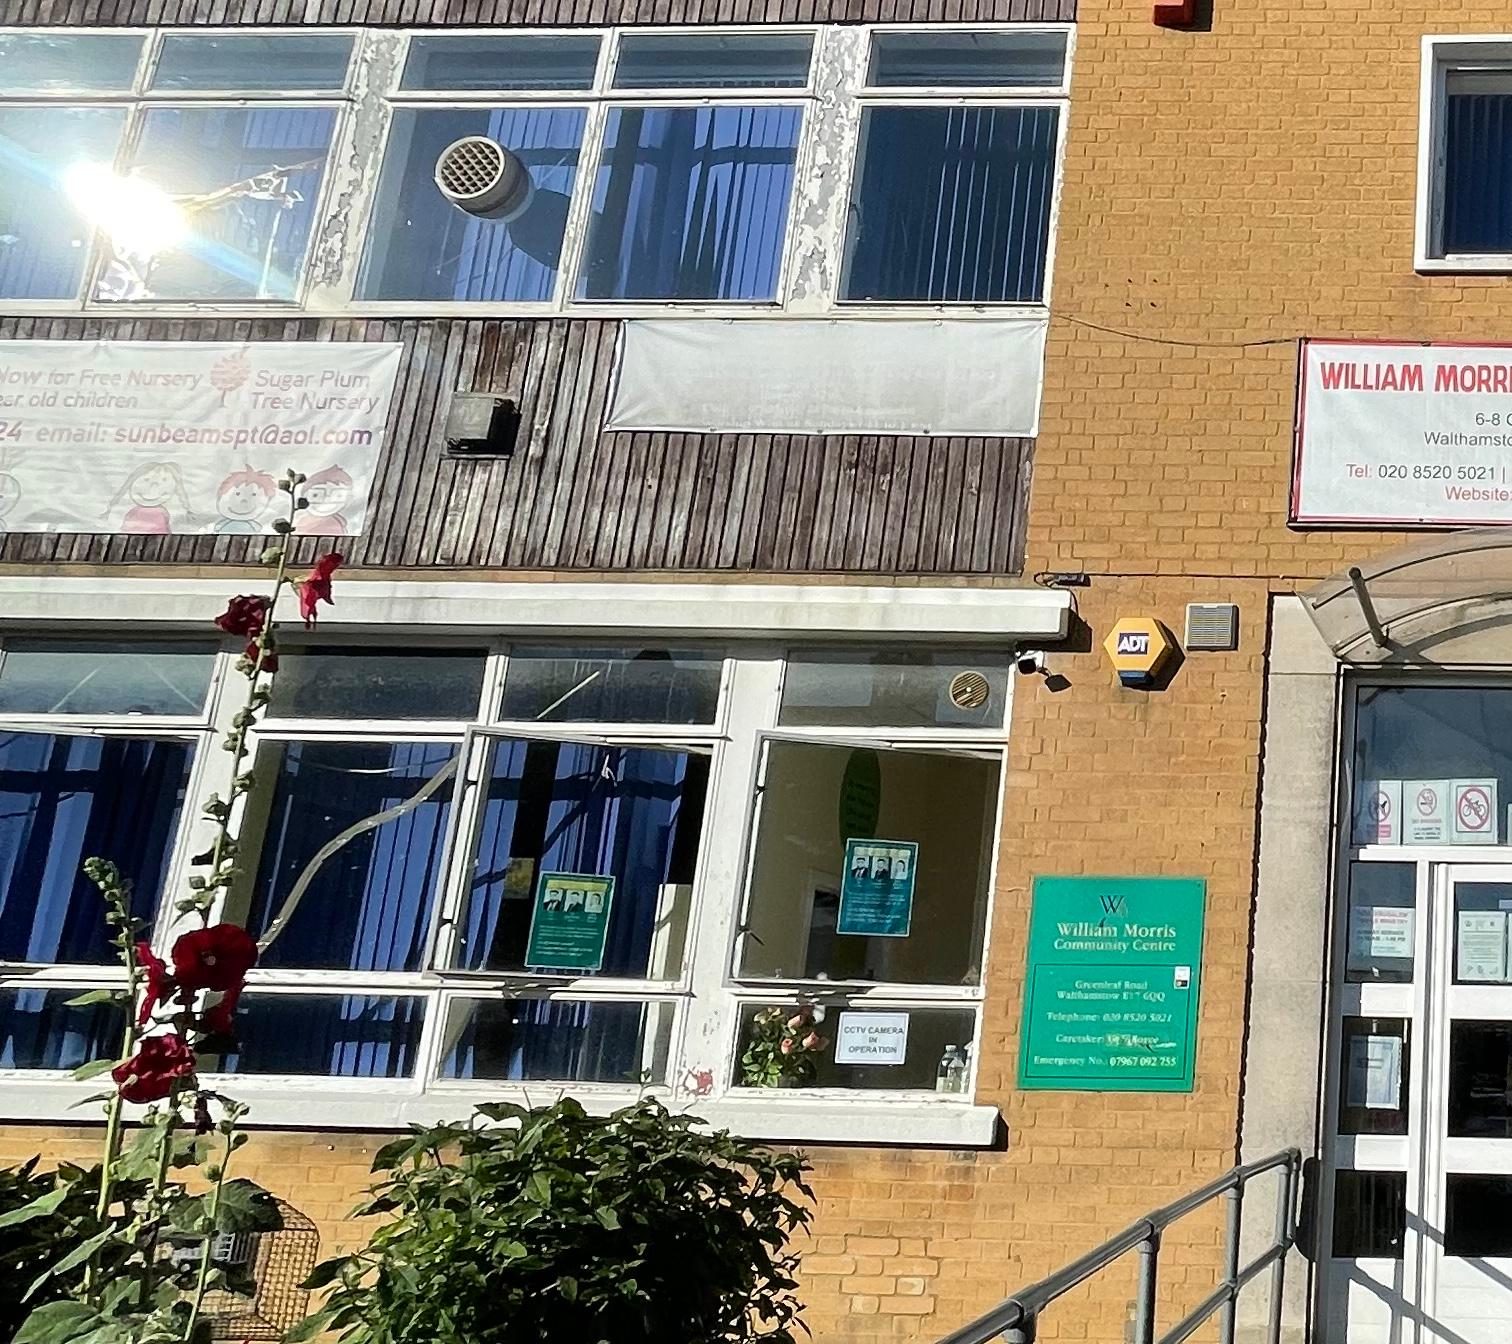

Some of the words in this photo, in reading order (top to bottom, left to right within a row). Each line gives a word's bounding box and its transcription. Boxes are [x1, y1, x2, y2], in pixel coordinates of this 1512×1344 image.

[48, 368, 75, 386] for
[79, 368, 122, 387] Free
[127, 369, 204, 392] Nursery
[255, 369, 314, 391] Sugar
[319, 369, 371, 388] Plum
[1320, 362, 1424, 391] WILLIAM
[28, 391, 59, 408] old
[63, 390, 138, 409] children
[251, 391, 295, 411] Tree
[300, 392, 380, 415] Nursery
[1475, 412, 1501, 427] 6-8
[36, 421, 107, 443] email:
[113, 423, 373, 451] sunbeamspt@aol.com
[1346, 464, 1372, 479] Tel:
[1378, 464, 1408, 479] 020
[1412, 465, 1453, 480] 8520
[1457, 466, 1495, 481] 5021
[1118, 635, 1149, 653] ADT
[1056, 921, 1117, 937] William
[1124, 923, 1177, 938] Morris
[1053, 938, 1130, 954] Community
[1132, 939, 1177, 952] Centre
[1124, 981, 1148, 990] Road
[844, 1026, 867, 1034] CCTV
[868, 1026, 904, 1035] CAMERA
[848, 1045, 897, 1054] OPERATION
[1109, 1056, 1138, 1067] 07967
